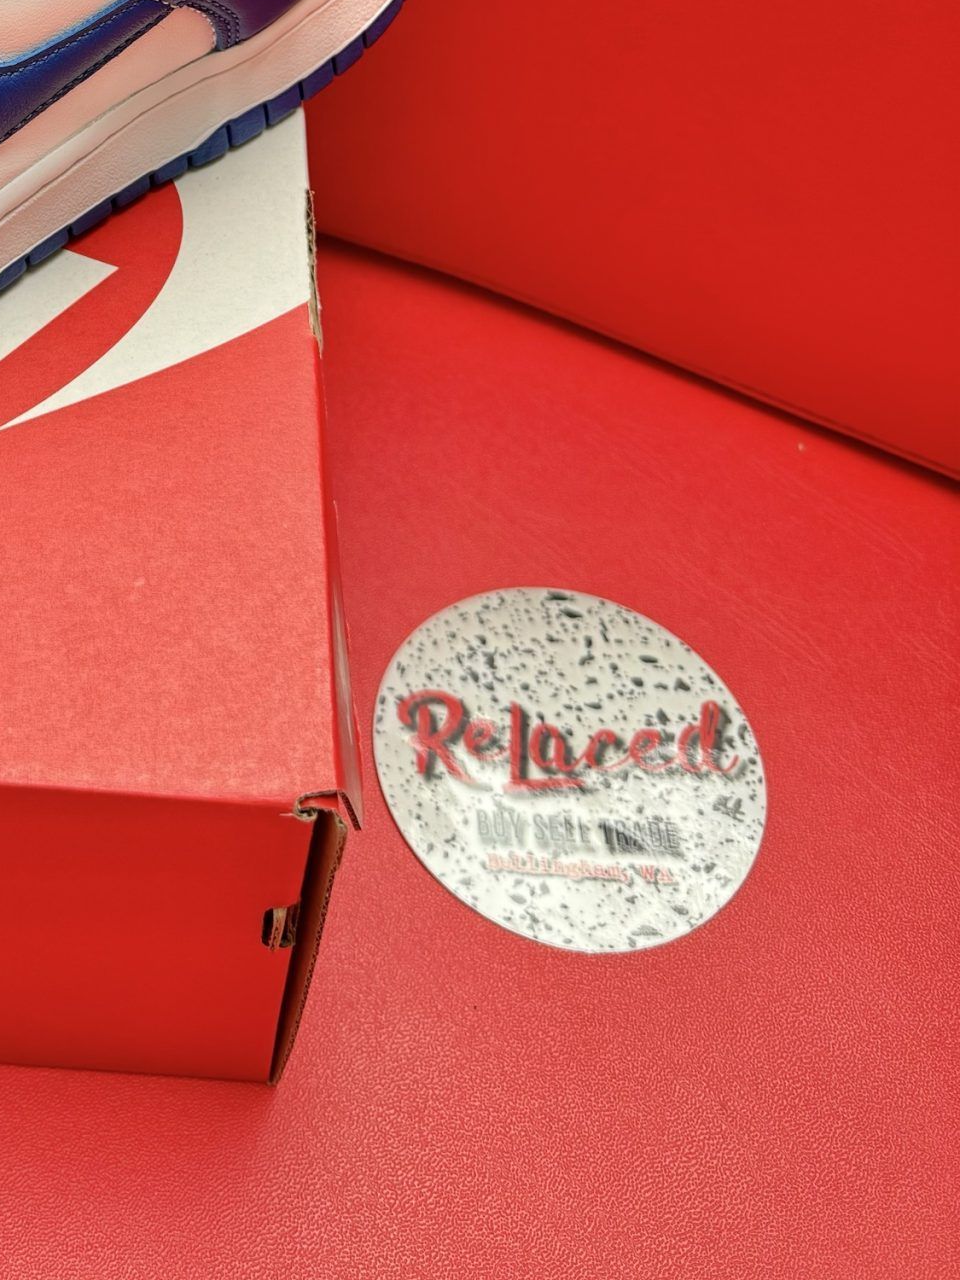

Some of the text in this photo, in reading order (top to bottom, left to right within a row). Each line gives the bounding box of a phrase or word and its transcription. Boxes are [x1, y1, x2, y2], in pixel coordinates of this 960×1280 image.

[476, 809, 681, 851] BUY SELL TRADE
